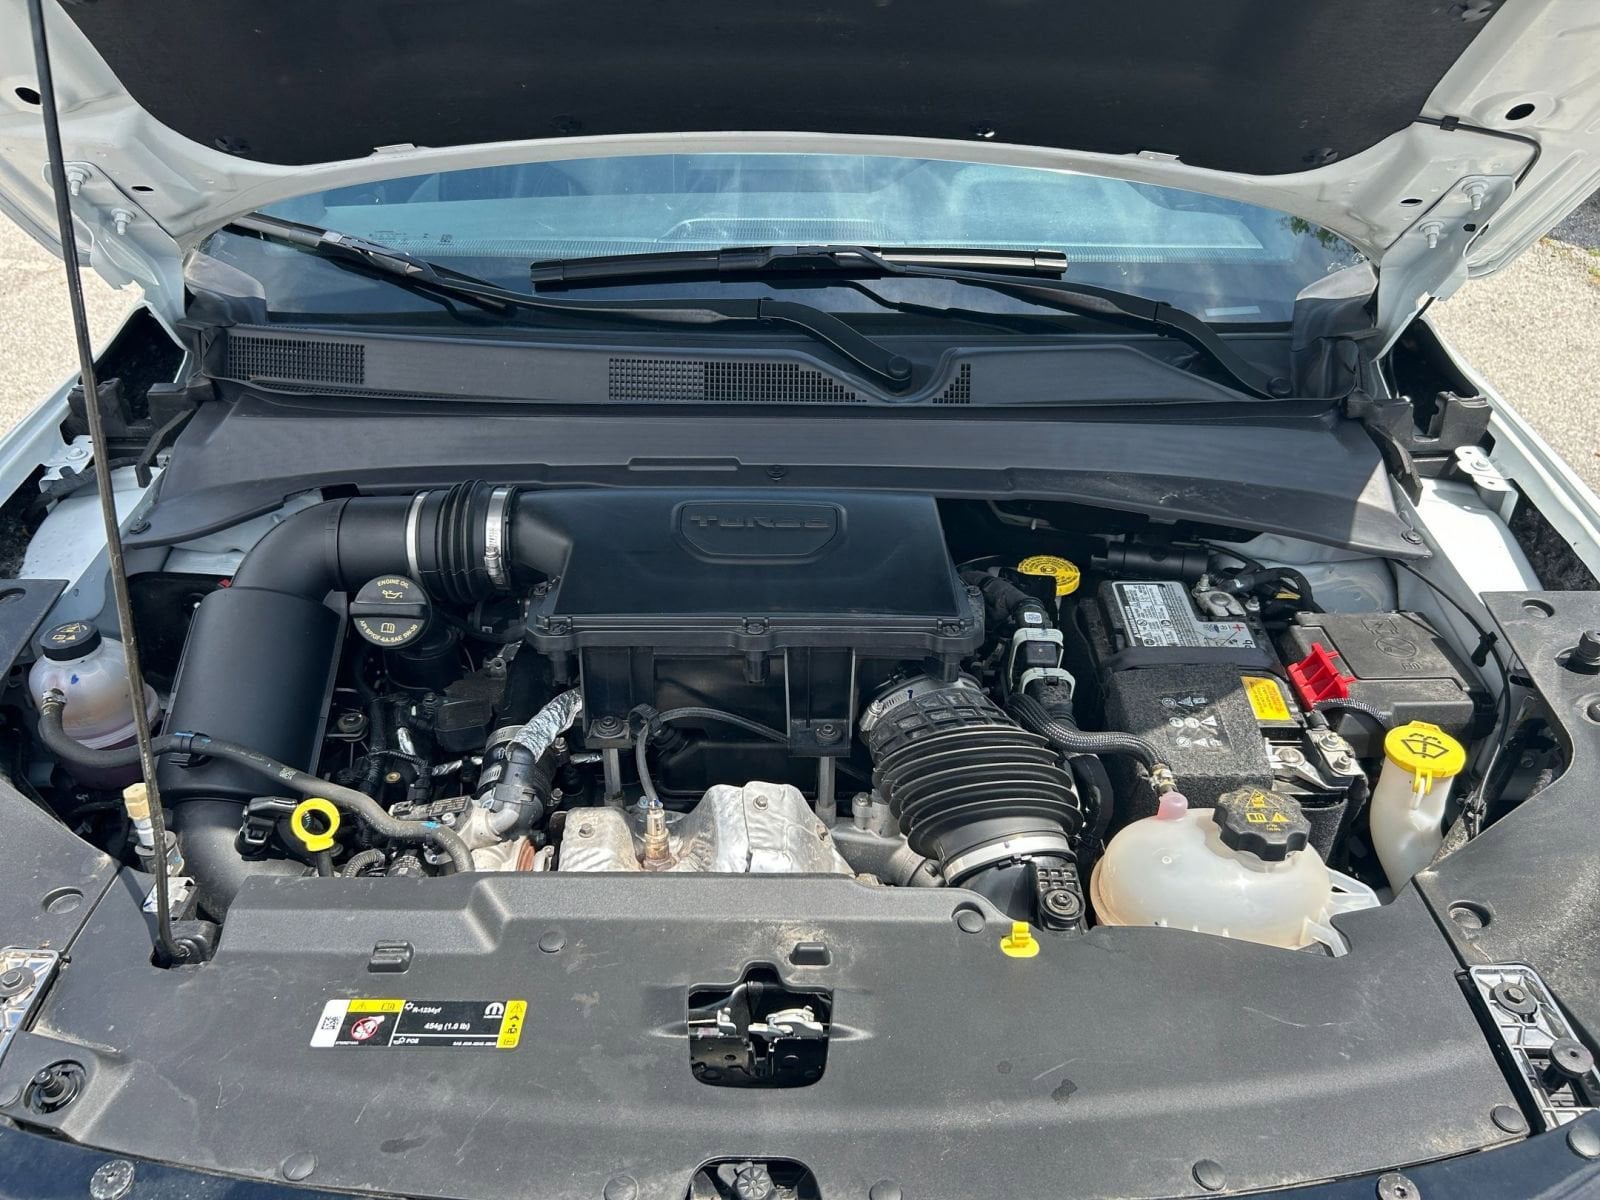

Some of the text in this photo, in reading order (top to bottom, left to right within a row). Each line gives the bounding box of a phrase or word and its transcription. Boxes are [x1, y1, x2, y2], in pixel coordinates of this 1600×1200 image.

[377, 578, 400, 587] ENGINE
[411, 1006, 442, 1015] R-1234yf
[424, 1022, 471, 1031] 454g (1.0 lb)
